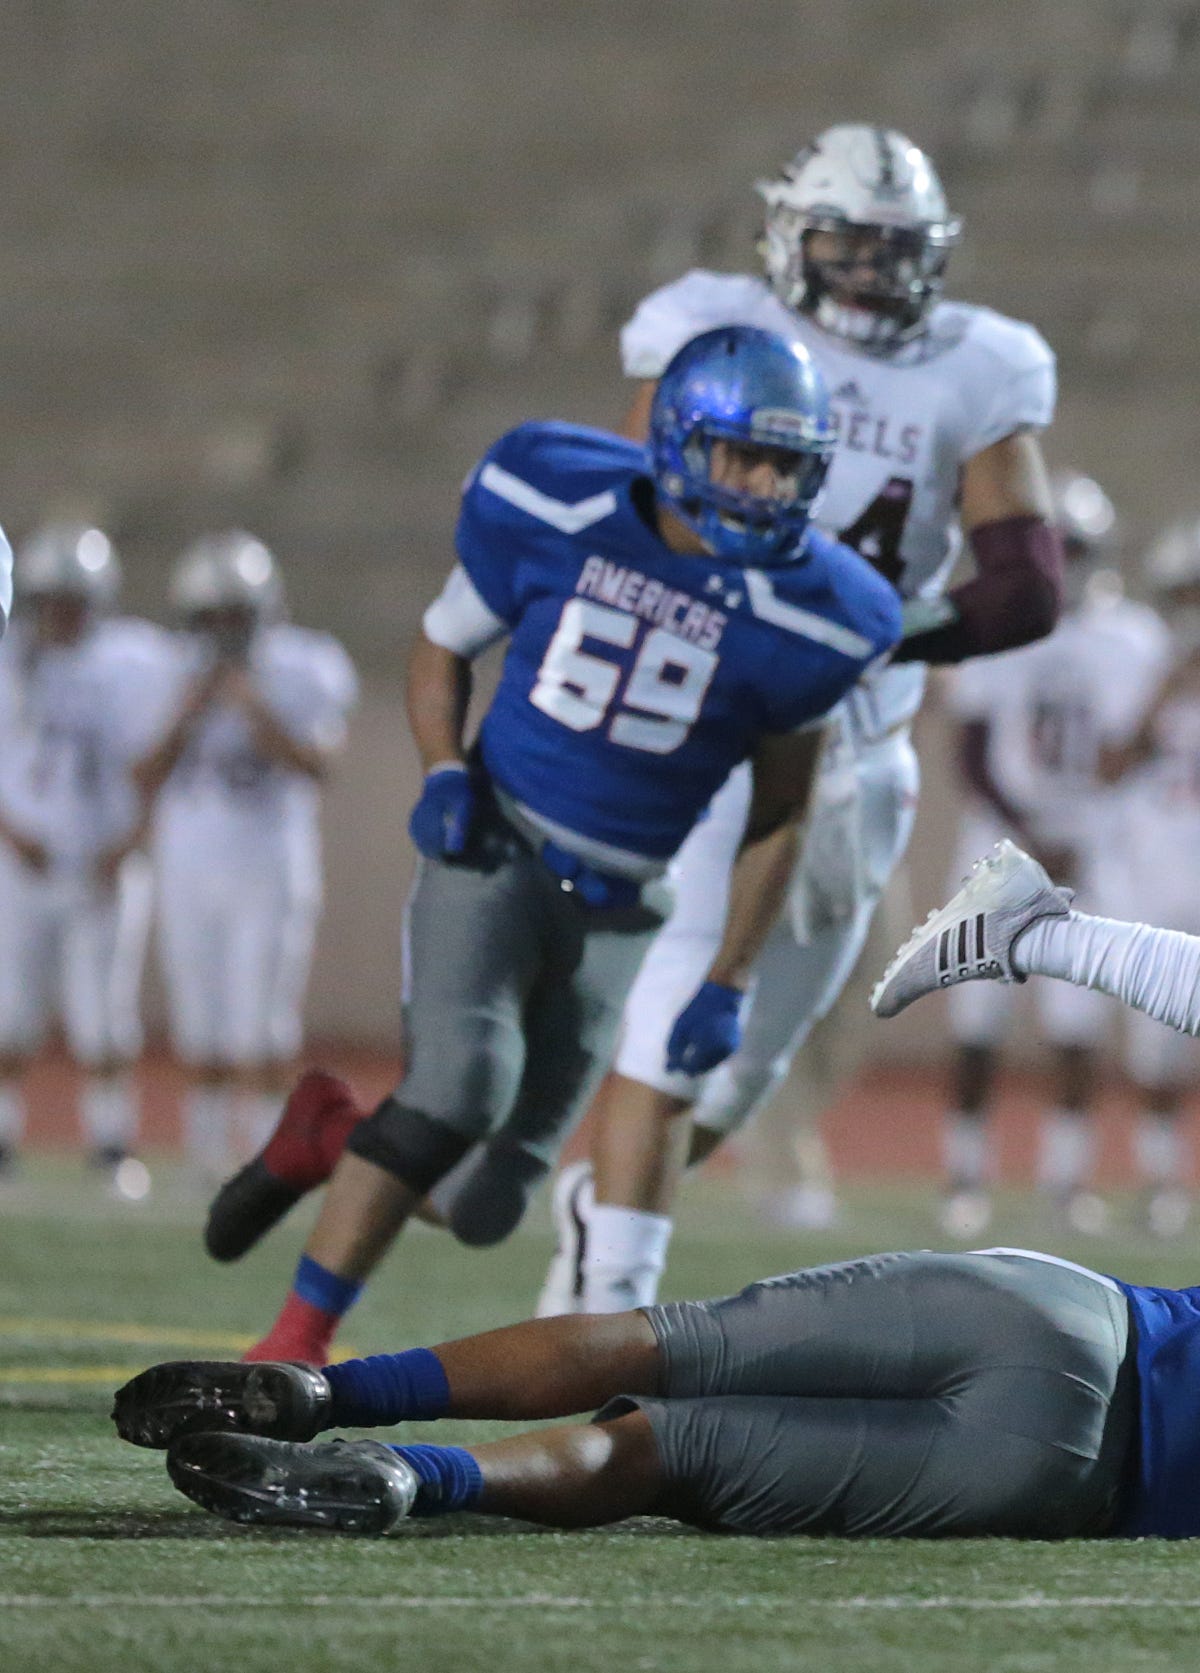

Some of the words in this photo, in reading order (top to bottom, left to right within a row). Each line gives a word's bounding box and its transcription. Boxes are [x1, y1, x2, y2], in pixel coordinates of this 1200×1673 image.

[831, 411, 921, 464] ELS
[837, 476, 914, 590] 4
[576, 554, 728, 651] AMERICAS
[529, 596, 720, 756] 69
